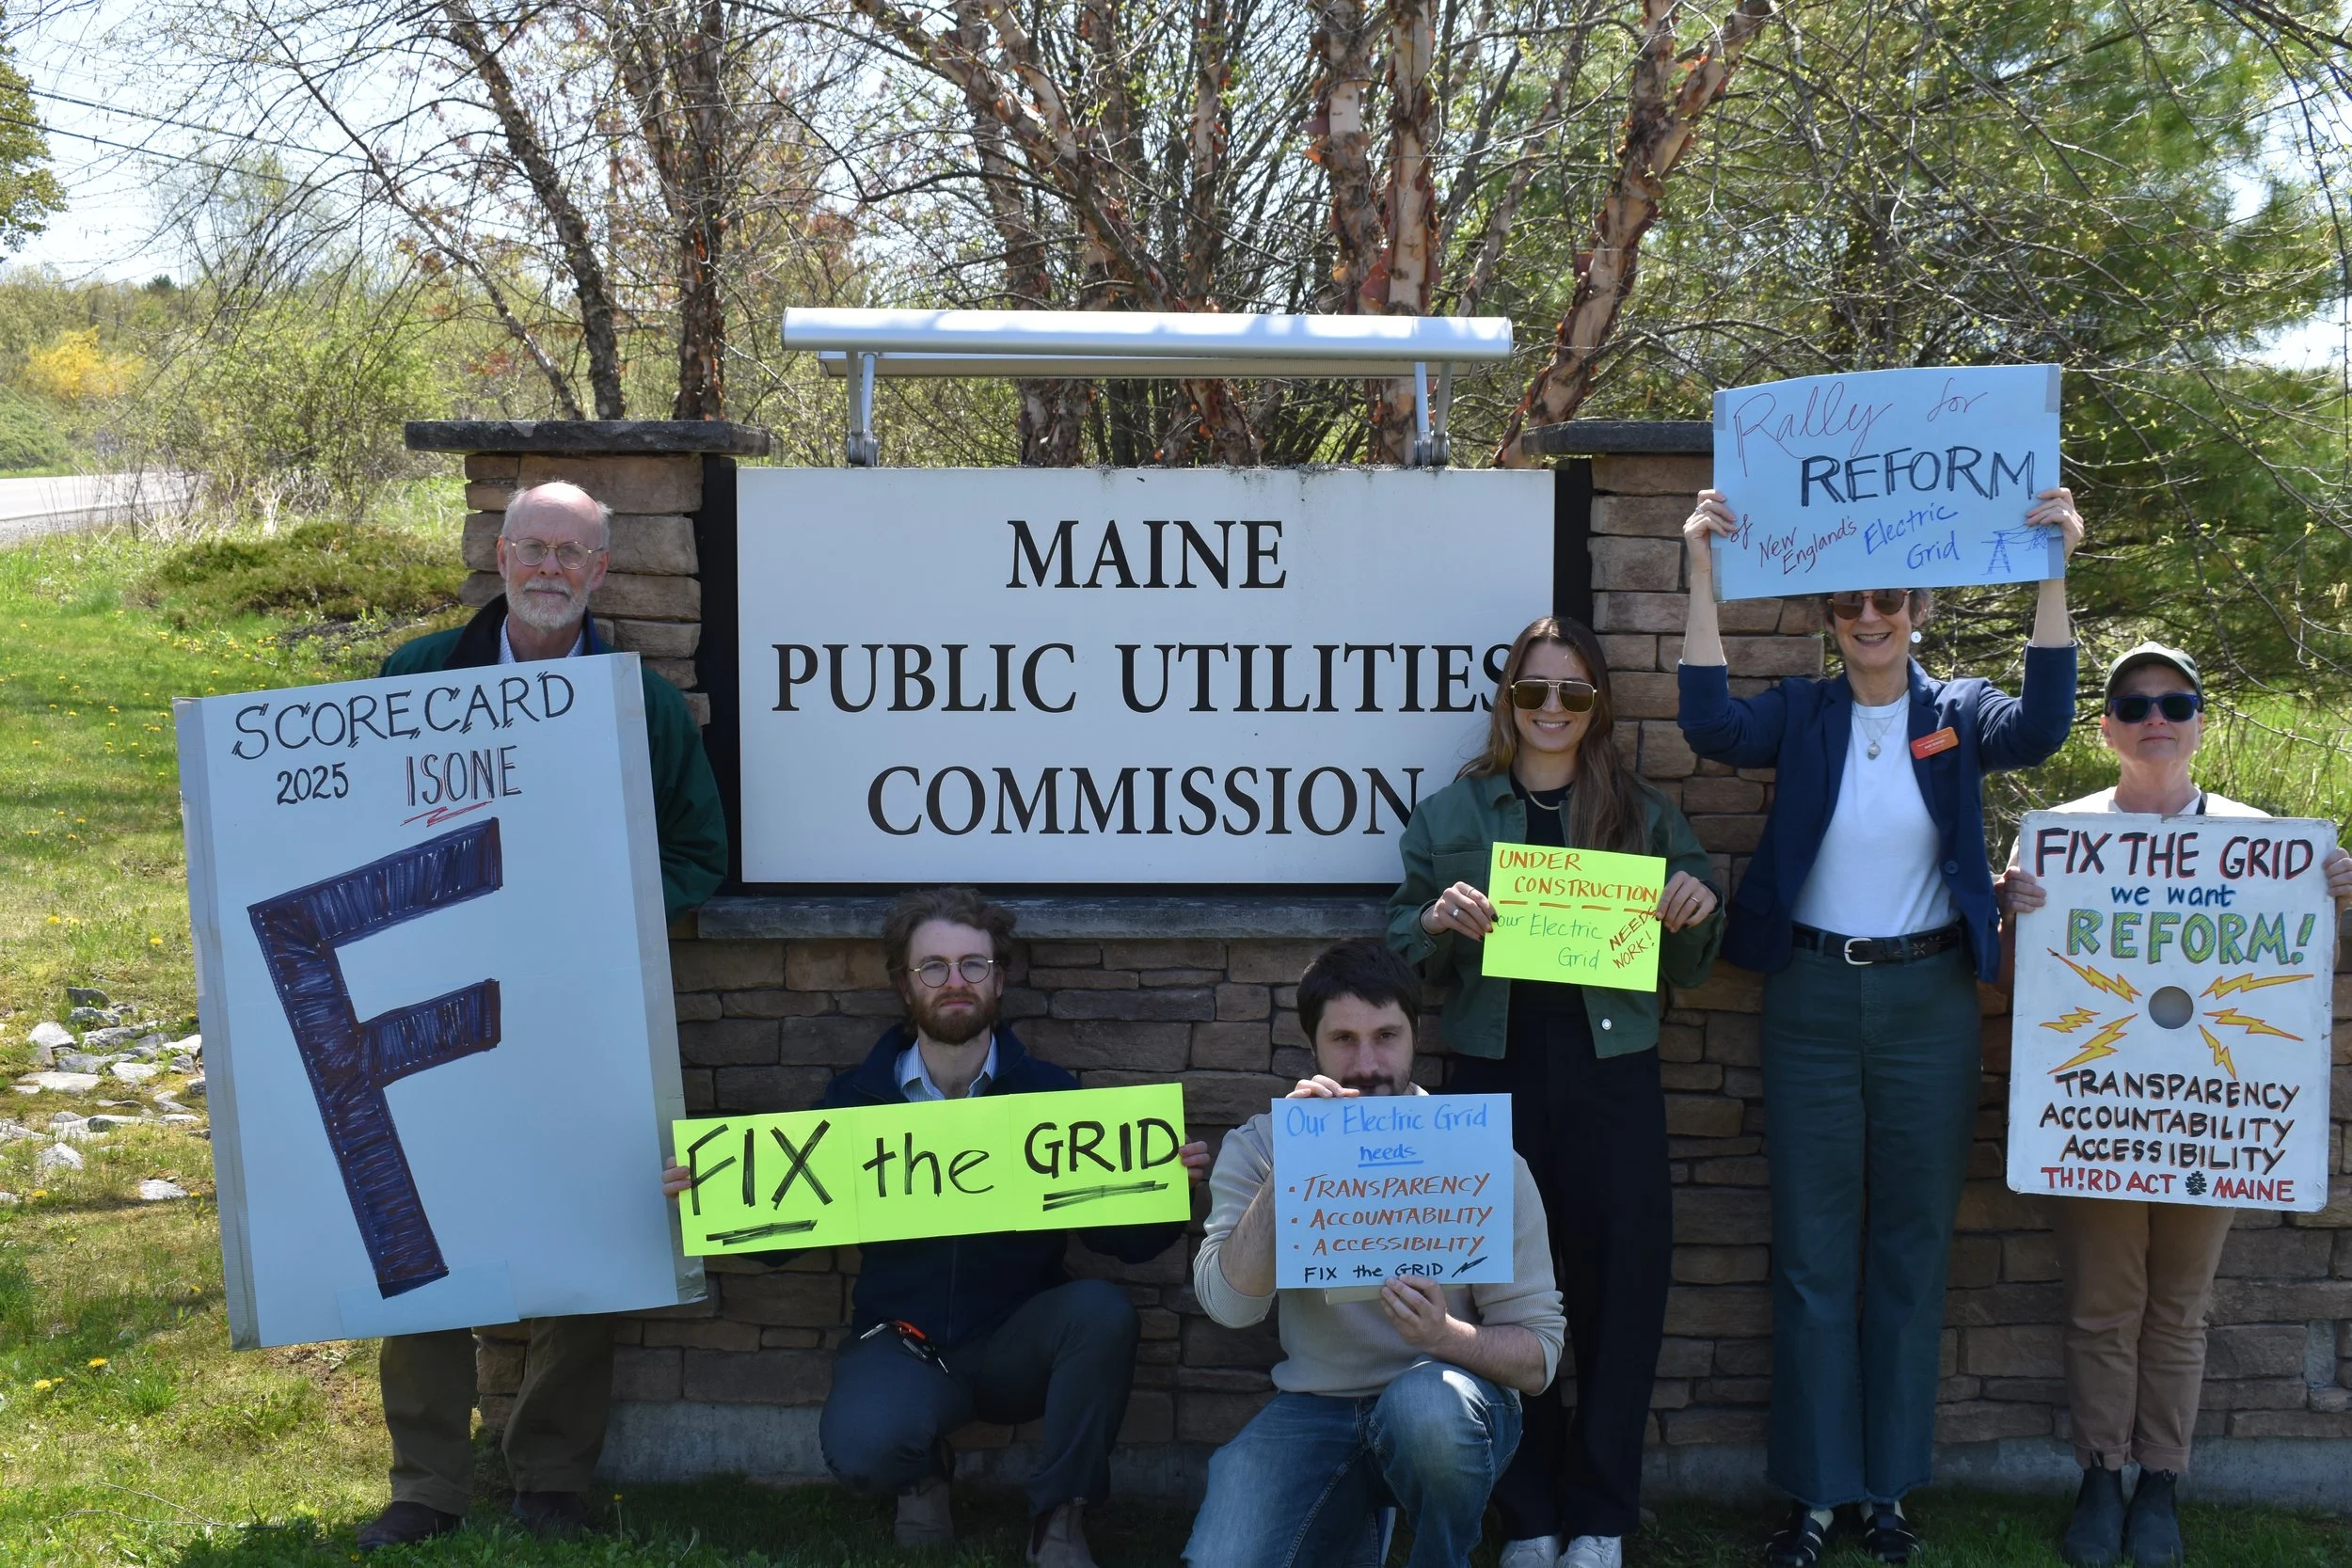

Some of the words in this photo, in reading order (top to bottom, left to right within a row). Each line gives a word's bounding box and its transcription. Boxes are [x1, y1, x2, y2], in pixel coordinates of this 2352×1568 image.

[1734, 382, 1894, 477] Rally
[1927, 378, 1988, 421] for
[1802, 447, 2034, 507] REFORM
[1730, 514, 1753, 549] of
[1759, 527, 1797, 567] New
[1783, 515, 1857, 576] England's
[1864, 503, 1959, 555] Electric
[1907, 531, 1960, 569] Grid
[1006, 519, 1286, 589] MAINE
[771, 643, 1076, 713] PUBLIC
[231, 672, 575, 760] SCORECARD
[277, 762, 349, 805] 2025
[406, 746, 522, 807] ISONE
[868, 766, 1423, 836] COMMISSION
[1499, 849, 1582, 871] UNDER
[2035, 828, 2112, 878] FIX
[2119, 832, 2198, 879] THE
[2219, 836, 2314, 880] GRID
[1515, 876, 1658, 903] CONSTRUCTION
[2110, 884, 2151, 905] we
[2168, 883, 2236, 908] want
[1529, 912, 1603, 940] Electric
[1610, 906, 1658, 951] NEEDS
[2067, 908, 2315, 965] REFORM!
[1558, 946, 1599, 970] Grid
[1612, 930, 1655, 969] WORK!
[247, 817, 503, 1300] F
[2054, 1069, 2300, 1113] TRANSPARENCY
[1286, 1105, 1330, 1137] Our
[1343, 1104, 1424, 1134] Electric
[1434, 1102, 1486, 1131] Grid
[2039, 1101, 2295, 1148] ACCOUNTABILITY
[687, 1119, 833, 1215] FIX
[863, 1132, 994, 1197] the
[1024, 1117, 1180, 1179] GRID
[1360, 1144, 1416, 1161] needs
[2059, 1134, 2285, 1176] ACCESSIBILITY
[1303, 1172, 1490, 1202] TRANSPARENCY
[2126, 1171, 2177, 1195] ACT
[2212, 1175, 2296, 1203] MAINE
[1310, 1206, 1493, 1230] ACCOUNTABILITY
[1312, 1235, 1485, 1257] ACCESSIBILITY
[1305, 1266, 1338, 1283] FIX
[1353, 1264, 1384, 1278] the
[1394, 1263, 1443, 1277] GRID
